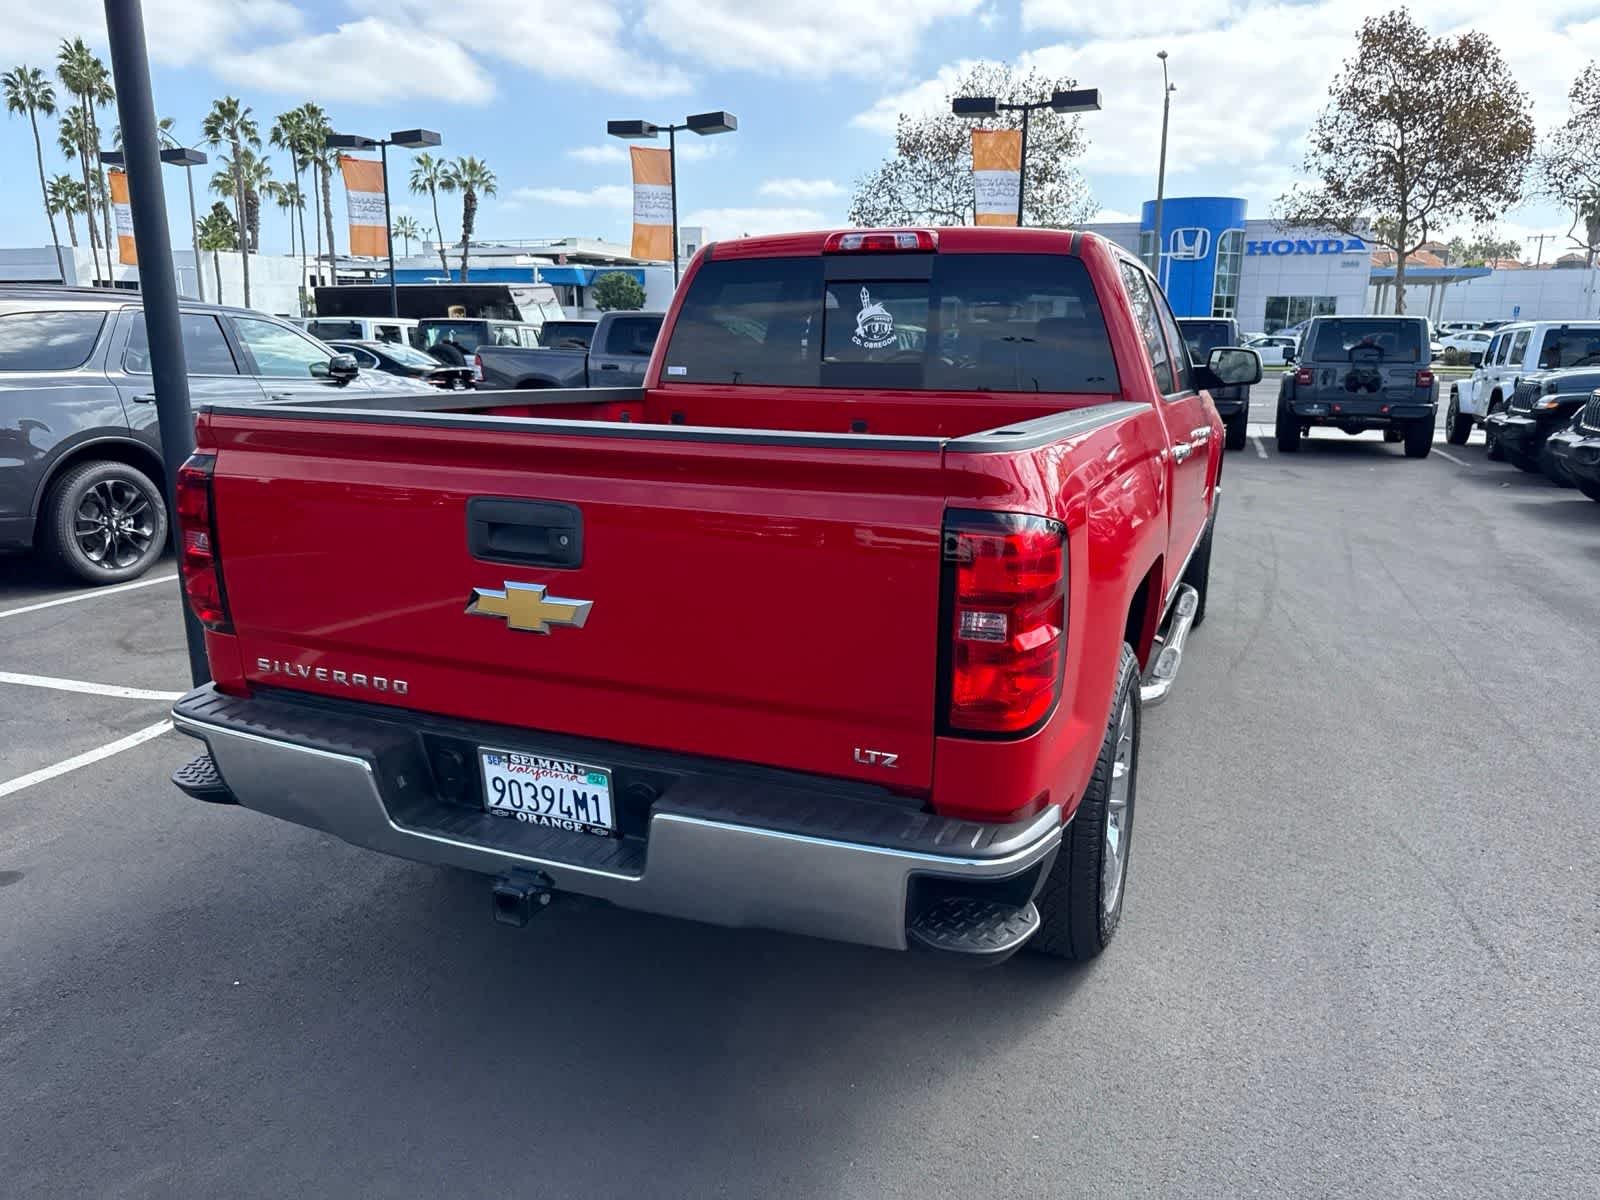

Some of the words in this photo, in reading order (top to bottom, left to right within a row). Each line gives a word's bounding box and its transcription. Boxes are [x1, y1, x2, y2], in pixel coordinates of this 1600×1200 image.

[1246, 239, 1366, 256] HONDA
[257, 657, 409, 694] SILVERADO
[509, 754, 575, 774] SELMAN
[854, 748, 899, 768] LTZ
[492, 776, 607, 826] 90394M1
[516, 812, 584, 833] ORANGE
